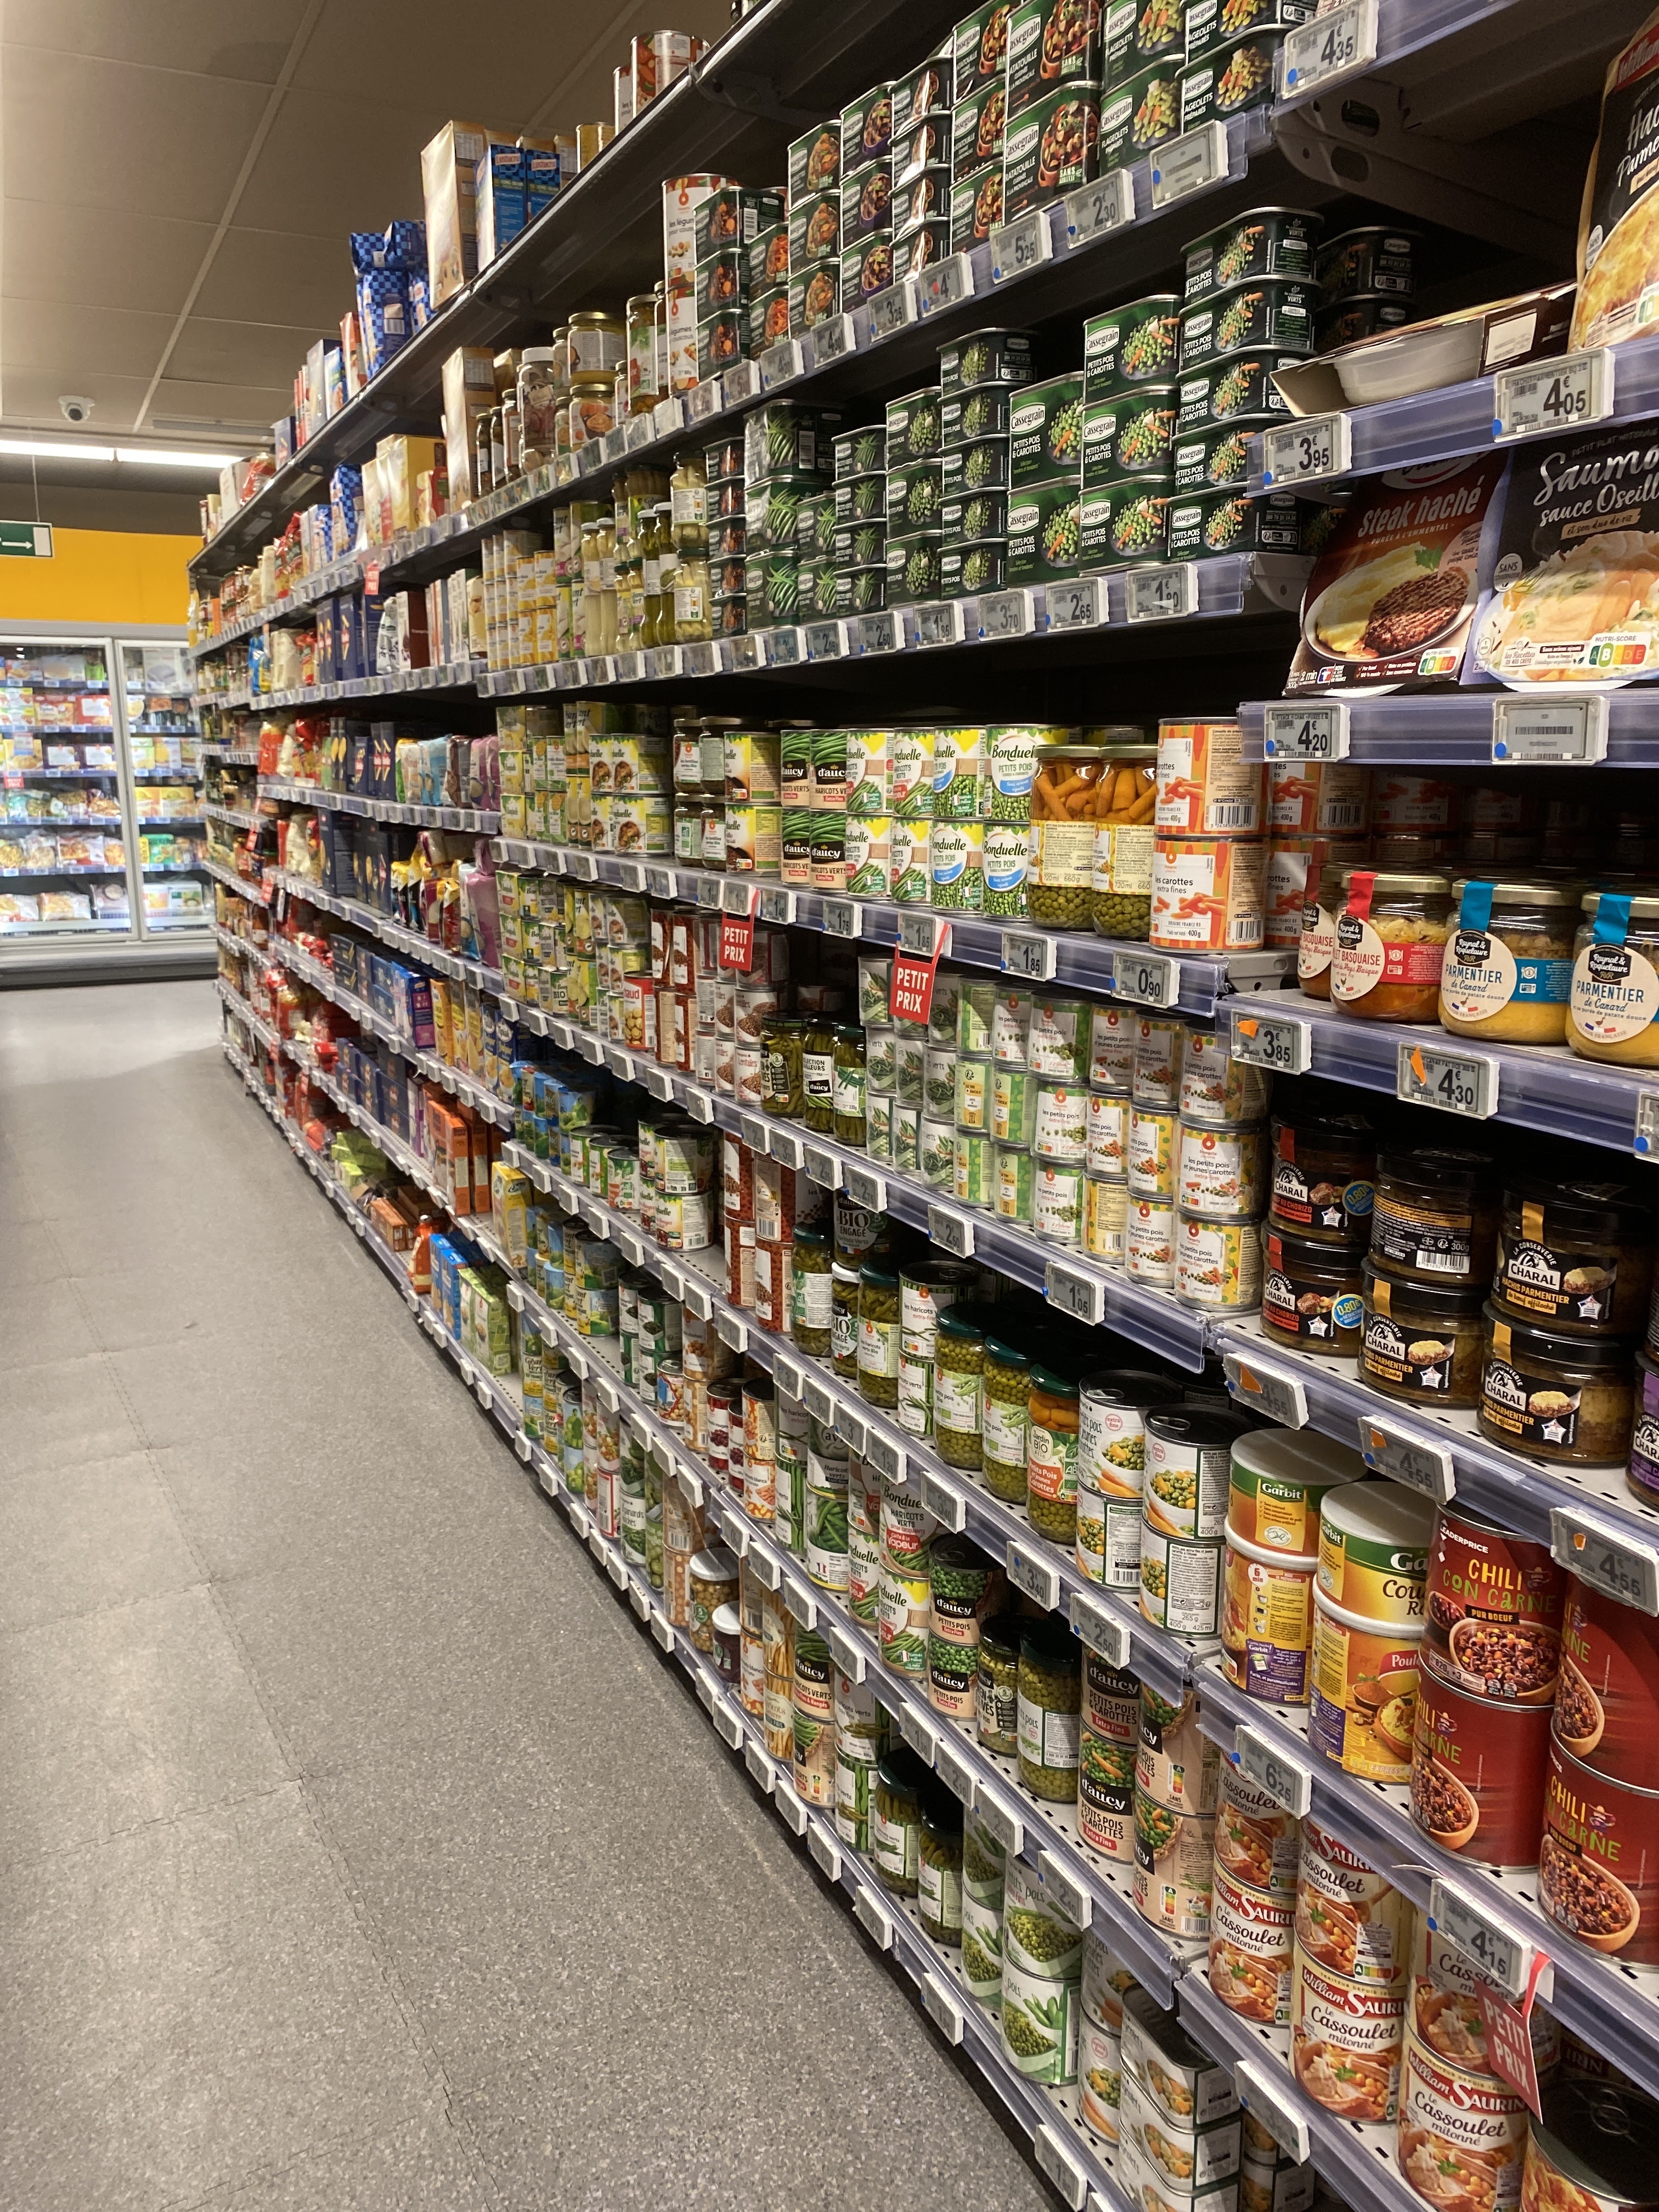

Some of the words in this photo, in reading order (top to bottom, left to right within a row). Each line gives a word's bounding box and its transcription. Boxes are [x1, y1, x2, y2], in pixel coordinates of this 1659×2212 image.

[1086, 330, 1118, 351] Cassegrain
[1199, 334, 1212, 346] POIS
[1186, 342, 1211, 358] CAROTTES
[1088, 358, 1101, 368] PETITS
[1102, 354, 1114, 365] POIS
[1092, 362, 1115, 375] CAROTTES
[1181, 382, 1209, 399] Cassegrain
[1543, 376, 1586, 417] 4€05
[1011, 408, 1045, 429] Cassegrain
[1182, 408, 1207, 421] CAROTTES
[1084, 420, 1115, 438] Cassegrain
[1013, 437, 1028, 449] PETITS
[1028, 435, 1040, 446] POIS
[1017, 444, 1041, 456] CAROTTES
[1086, 446, 1099, 456] PETITS
[1099, 443, 1111, 453] POIS
[1089, 450, 1111, 462] CAROTTES
[1300, 437, 1329, 471] 3€95
[1081, 504, 1110, 522] Cassegrain
[1358, 500, 1416, 538] Steak
[1414, 475, 1485, 525] haché
[1539, 499, 1592, 527] sauce
[1008, 510, 1038, 530] Cassegrain
[1172, 510, 1201, 525] Cassegrain
[1009, 538, 1023, 548] PETITS
[1023, 536, 1035, 546] POIS
[1082, 531, 1094, 540] PETITS
[1095, 528, 1106, 538] POIS
[1086, 535, 1106, 546] CAROTTES
[1173, 536, 1200, 548] CAROTTES
[1186, 529, 1200, 539] POIS
[1371, 534, 1394, 545] PURÉE
[1013, 544, 1035, 555] CAROTTES
[1499, 561, 1519, 572] SANS
[1070, 593, 1091, 621] 2€65
[1298, 720, 1328, 752] 4€20
[1018, 763, 1032, 771] POIS
[812, 848, 840, 859] d'aucy
[984, 840, 1028, 857] Bonduelle
[988, 860, 1002, 868] PETITS
[1162, 878, 1193, 886] carottes
[1170, 885, 1187, 894] fines
[724, 927, 748, 945] PETIT
[1304, 935, 1333, 947] BASQUAISE
[724, 945, 744, 963] PRIX
[1023, 946, 1040, 973] 1€85
[1342, 952, 1381, 967] BASQUAISE
[1356, 966, 1379, 975] Basque
[1446, 963, 1502, 984] PARMENTIER
[897, 969, 928, 992] PETIT
[1138, 969, 1160, 997] 0€90
[1459, 981, 1487, 992] Canard
[896, 989, 922, 1013] PRIX
[1577, 981, 1644, 1003] PARMENTIER
[1584, 998, 1592, 1007] de
[1594, 1001, 1628, 1013] Canard
[1263, 1031, 1290, 1062] 3€85
[1438, 1068, 1474, 1105] 4€30
[1189, 1166, 1207, 1174] jeunes
[1276, 1181, 1306, 1198] CHARAL
[1288, 1201, 1312, 1213] CHORIZO
[839, 1210, 868, 1227] BIO
[1519, 1240, 1557, 1266] CONSERVERIE
[1510, 1263, 1557, 1287] CHARAL
[1069, 1284, 1088, 1313] 1€05
[1521, 1284, 1570, 1305] PARMENTIER
[911, 1305, 933, 1315] haricots
[1367, 1335, 1402, 1357] CHARAL
[1375, 1356, 1413, 1373] PARMENTIER
[1487, 1381, 1523, 1407] CHARAL
[1494, 1405, 1534, 1425] PARMENTIER
[1032, 1429, 1049, 1444] Jardin
[1042, 1468, 1057, 1480] Pois
[1262, 1483, 1302, 1499] Garbit
[891, 1508, 924, 1521] HARICOTS
[898, 1518, 915, 1528] VERTS
[1322, 1521, 1342, 1544] Garbit
[1440, 1524, 1488, 1554] LEADERPRICE
[1469, 1559, 1522, 1590] CHILI
[1598, 1553, 1640, 1597] 4€55
[936, 1598, 972, 1615] d'aucy
[1471, 1609, 1487, 1619] PUR
[1488, 1612, 1514, 1622] BOEUF
[939, 1617, 955, 1628] PETITS
[956, 1620, 970, 1630] POIS
[1090, 1665, 1139, 1694] d'aucy
[1090, 1690, 1114, 1711] PETITS
[1115, 1701, 1137, 1716] POIS
[1095, 1703, 1137, 1724] CAROTTES
[1266, 1762, 1291, 1803] 6€25
[1082, 1778, 1126, 1810] d'aucy
[1551, 1776, 1585, 1823] CHILI
[1227, 1792, 1259, 1815] mitonné
[1082, 1802, 1101, 1825] PETITS
[1103, 1817, 1123, 1831] POIS
[1087, 1816, 1124, 1839] CAROTTES
[1086, 1827, 1098, 1841] Extra
[1099, 1835, 1112, 1848] Fins
[1216, 1905, 1285, 1946] Cassoulet
[1226, 1931, 1263, 1953] mitonné
[1470, 1930, 1507, 1975] 4€15
[1304, 1968, 1345, 2006] William
[1325, 2006, 1334, 2017] Le
[1311, 2006, 1397, 2040] Cassoulet
[1483, 1996, 1527, 2058] PETIT
[1329, 2032, 1375, 2050] mitonné
[1493, 2035, 1531, 2094] PRIX
[1409, 2049, 1449, 2094] William
[1450, 2081, 1526, 2112] SAURIN
[1427, 2092, 1438, 2104] Le
[1415, 2091, 1506, 2138] Cassoulet
[1431, 2122, 1481, 2146] mitonné
